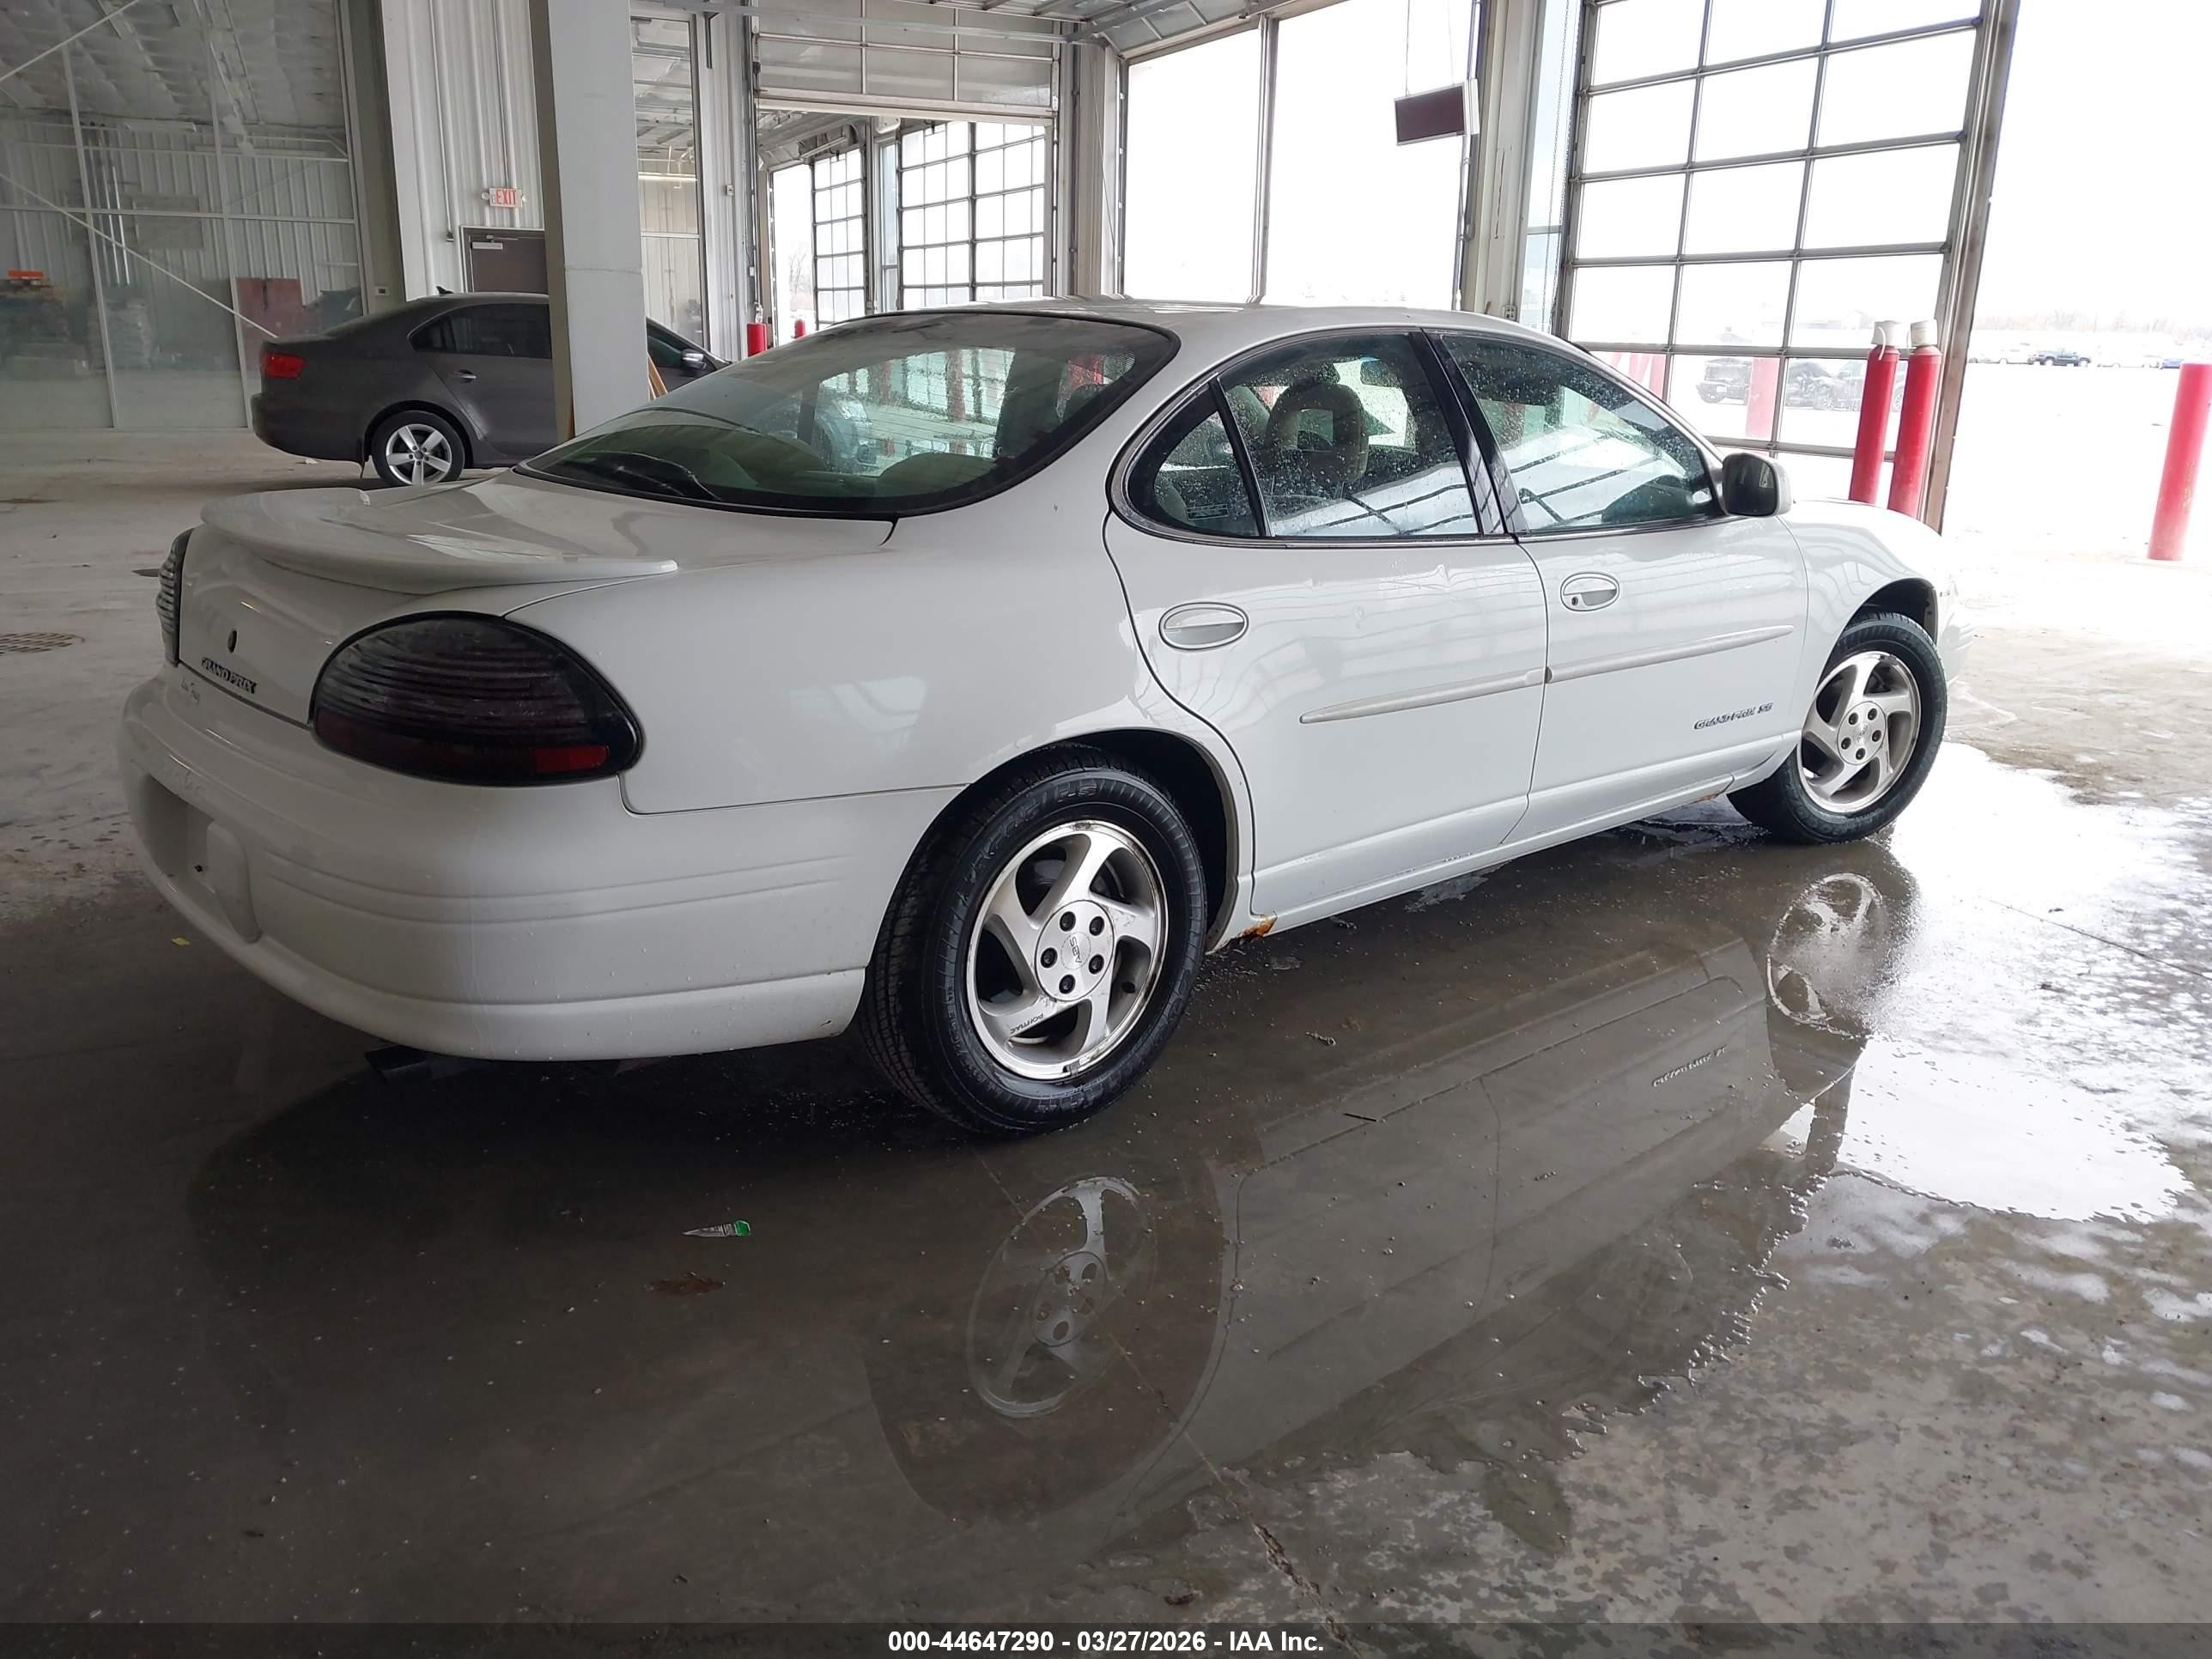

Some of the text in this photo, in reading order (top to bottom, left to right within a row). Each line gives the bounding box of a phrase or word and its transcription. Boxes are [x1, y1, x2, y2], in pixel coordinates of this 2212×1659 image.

[495, 189, 517, 206] EXIT
[1693, 712, 1735, 730] GRAND
[1069, 935, 1083, 963] ABS
[1009, 1012, 1044, 1035] PONTIAC
